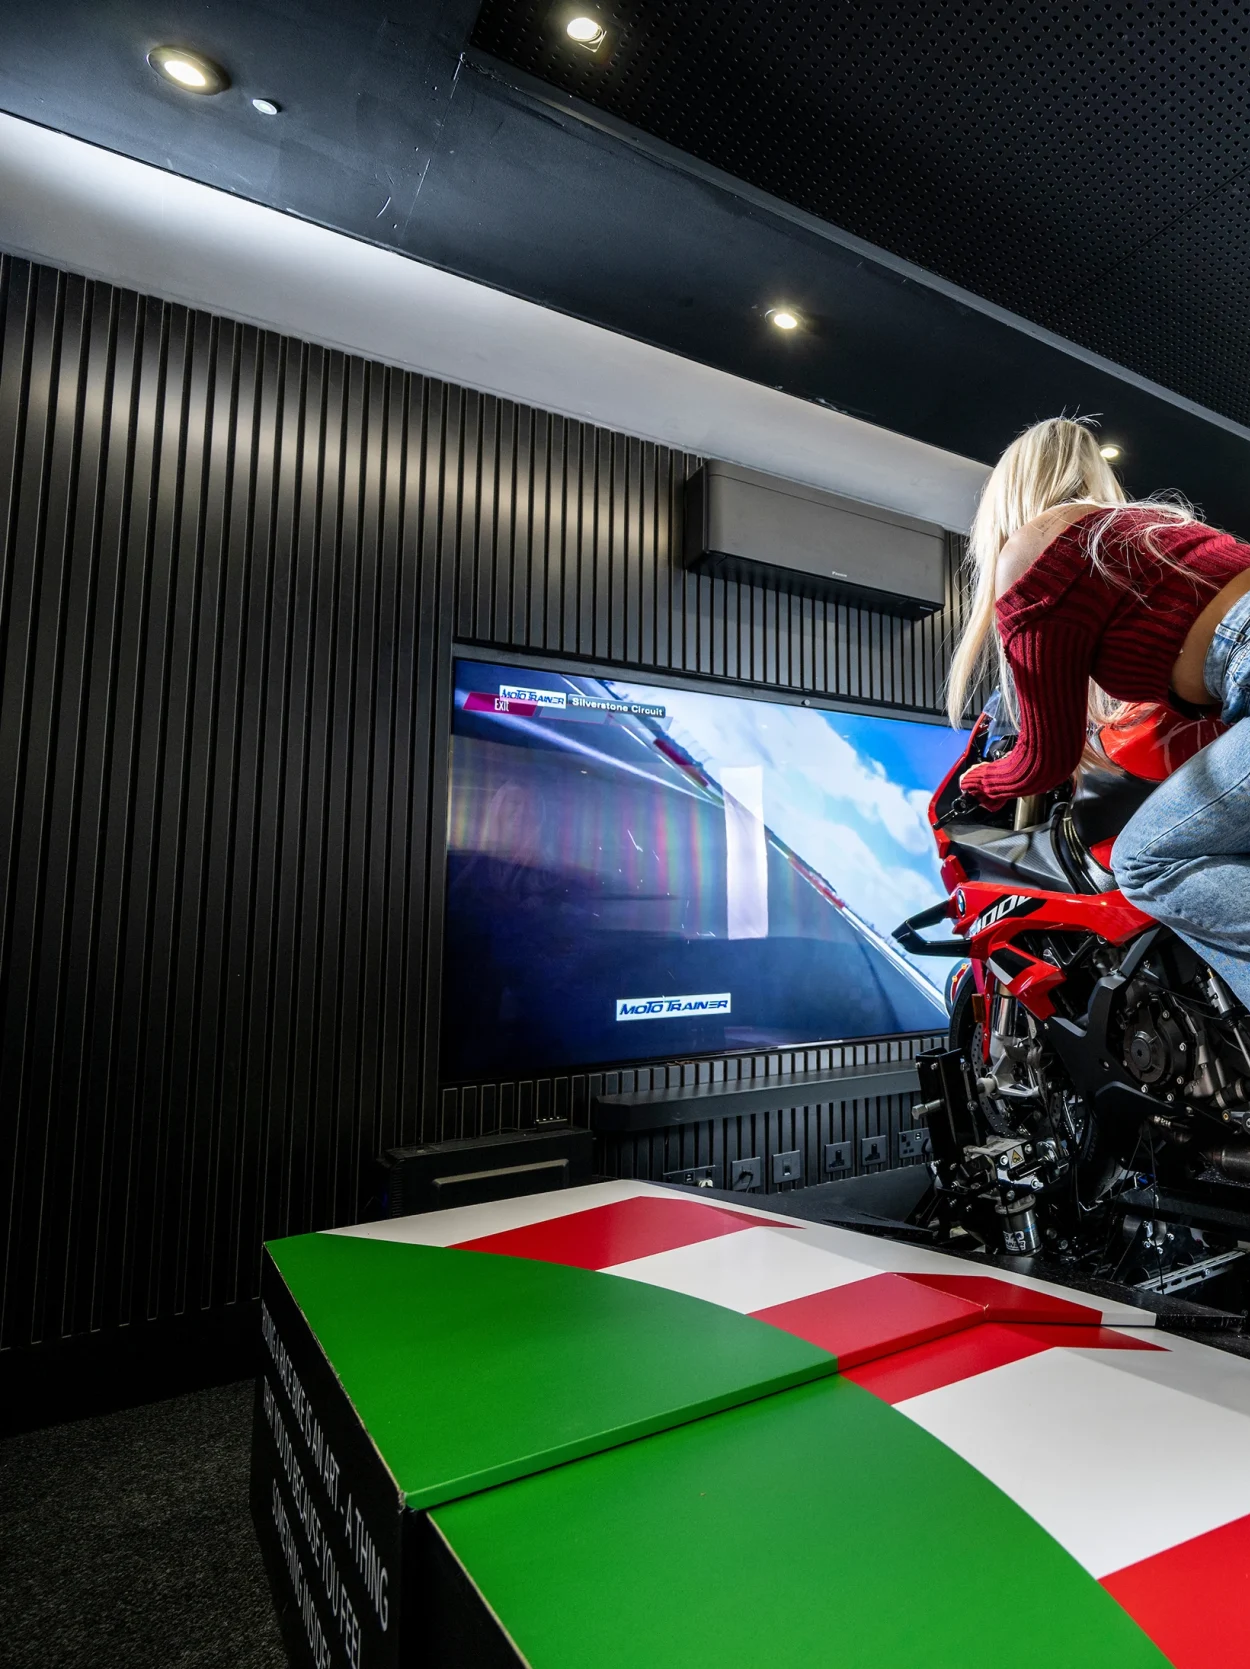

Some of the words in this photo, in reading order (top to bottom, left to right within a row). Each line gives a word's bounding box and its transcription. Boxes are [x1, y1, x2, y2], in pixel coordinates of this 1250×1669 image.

[494, 698, 510, 712] Exit
[572, 697, 629, 713] Silverstone
[631, 704, 664, 717] Circuit
[620, 1000, 664, 1015] MOTO
[663, 999, 729, 1012] TRAINER
[263, 1375, 275, 1429] THAT
[273, 1402, 285, 1459] YOU
[283, 1431, 293, 1483] DO
[292, 1455, 322, 1568] BECAUSE
[322, 1531, 340, 1617] YOU
[279, 1341, 293, 1401] RACE
[291, 1370, 306, 1432] BIKE
[304, 1400, 313, 1448] IS
[311, 1418, 324, 1475] AN
[323, 1444, 341, 1512] ART
[345, 1493, 353, 1549] A
[355, 1507, 389, 1632] THING
[272, 1478, 304, 1608] SOMETHING
